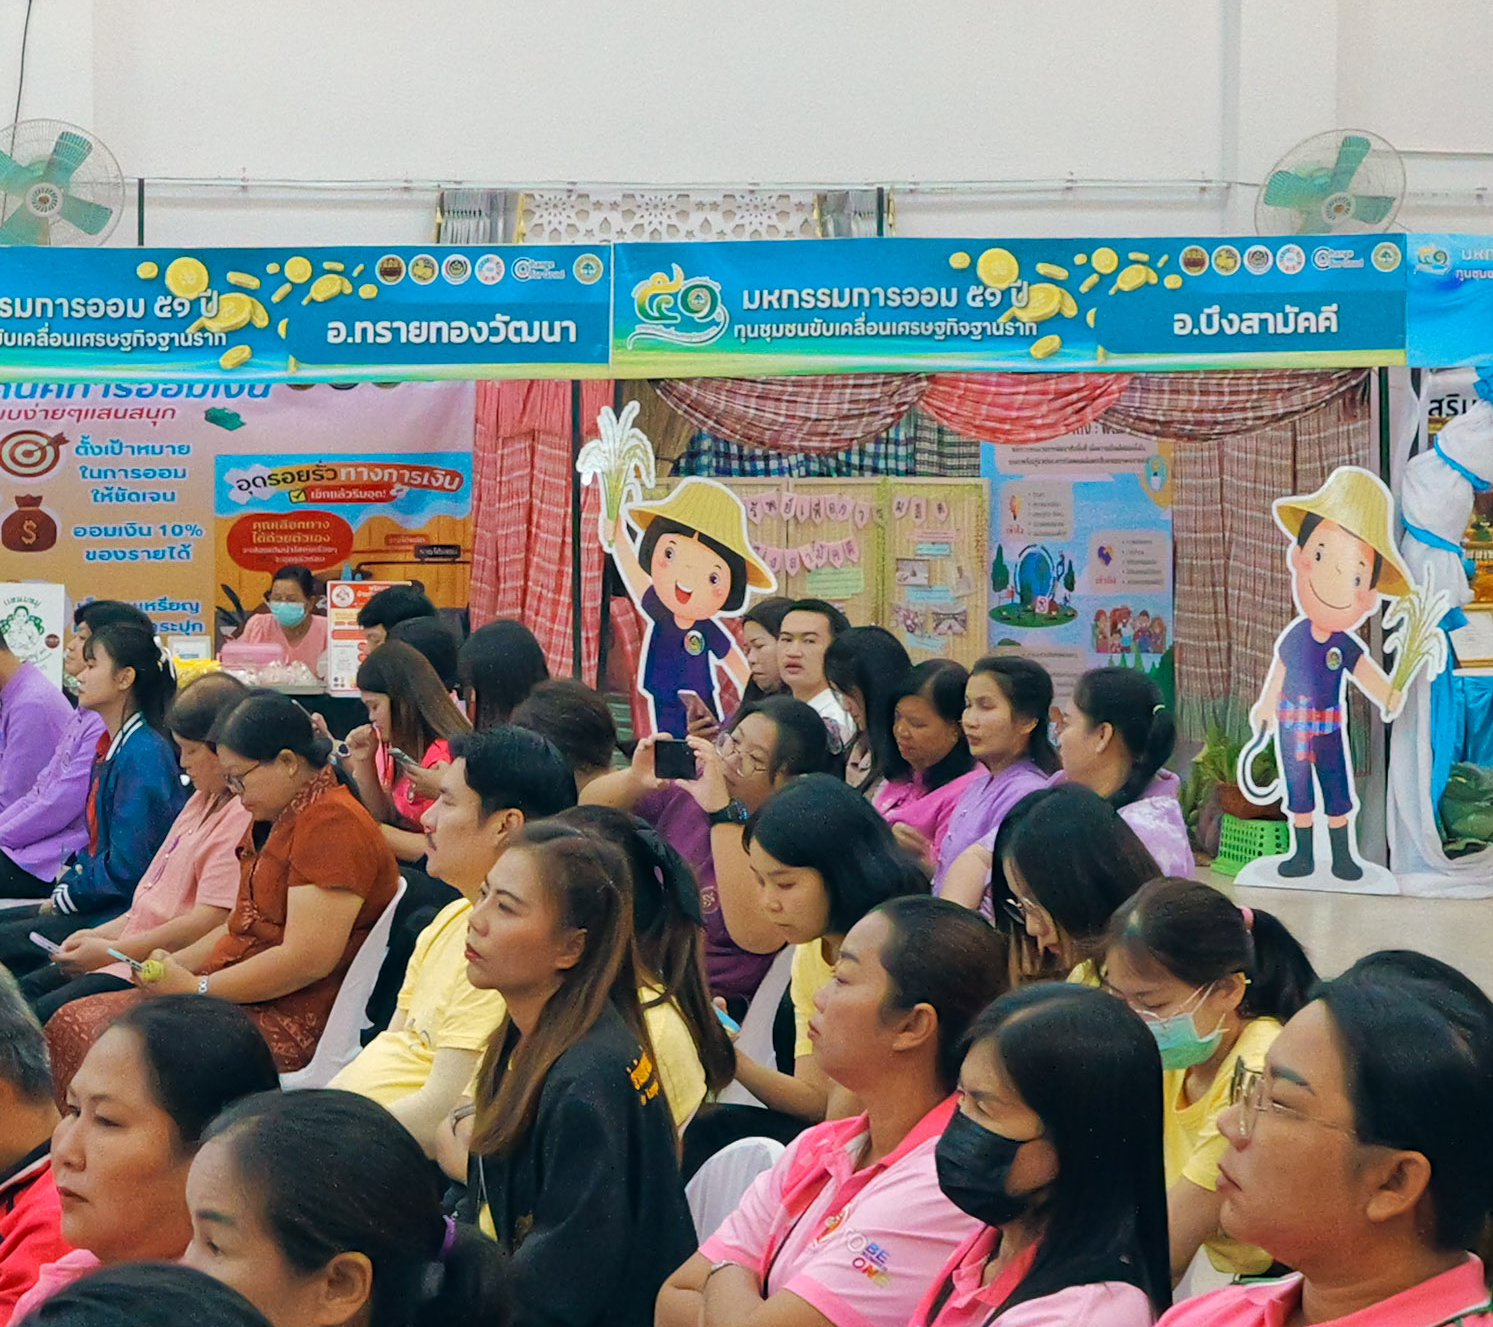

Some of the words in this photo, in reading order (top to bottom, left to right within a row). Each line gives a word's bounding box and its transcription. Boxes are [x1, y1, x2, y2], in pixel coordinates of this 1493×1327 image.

[154, 296, 191, 320] ๕๑
[199, 289, 219, 321] ปี
[741, 282, 959, 311] มหกรรมการออม
[965, 285, 1002, 310] ๕๑
[1009, 278, 1030, 309] ปี
[327, 313, 578, 346] อ.ทรายทองวัฒนา
[1172, 302, 1340, 338] อ.บึงสามัคคี
[74, 434, 192, 457] ตั้งเป้าหมาย
[80, 464, 187, 480] ในการออม
[91, 487, 176, 504] ให้ชัดเจน
[73, 522, 153, 539] ออมเงิน
[160, 523, 204, 538] 10%
[85, 543, 193, 562] ของรายได้
[866, 1241, 892, 1264] BE
[852, 1257, 893, 1288] ONE
